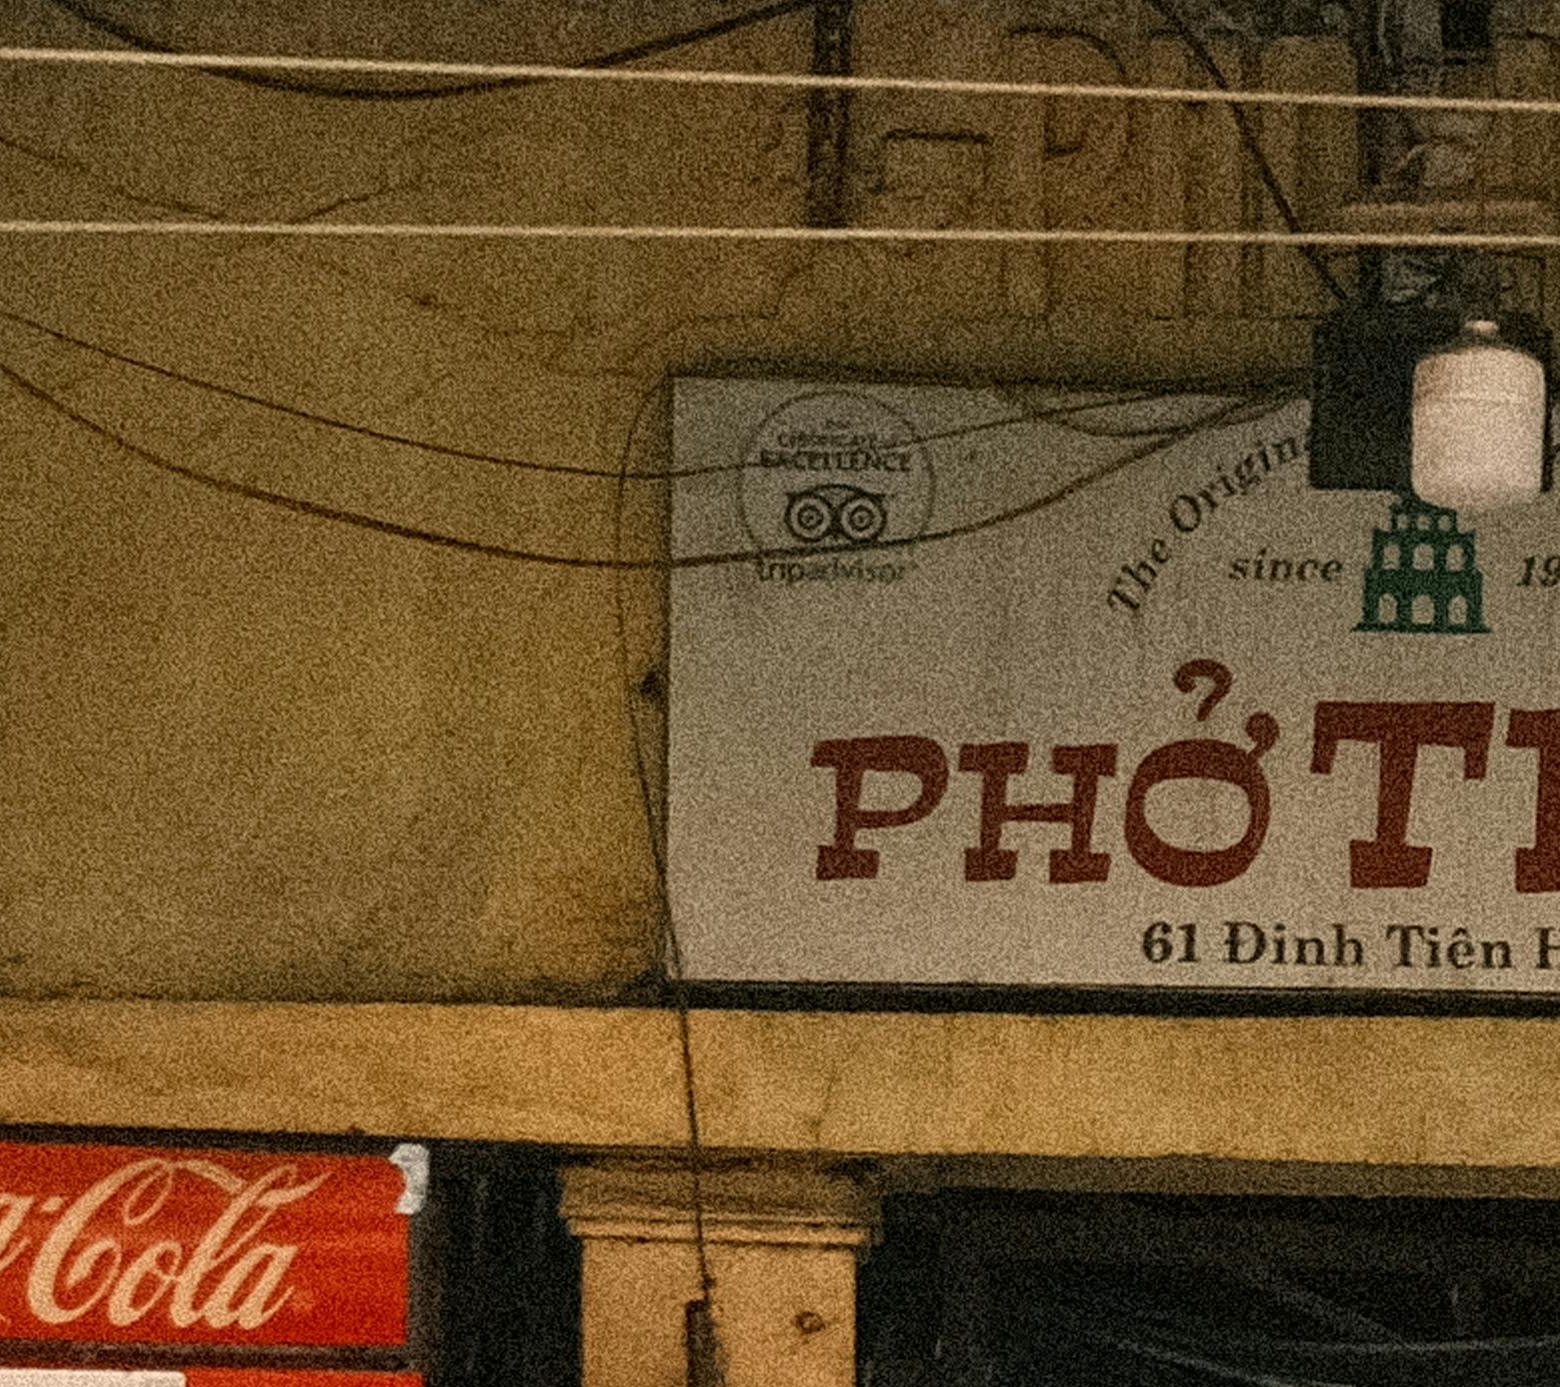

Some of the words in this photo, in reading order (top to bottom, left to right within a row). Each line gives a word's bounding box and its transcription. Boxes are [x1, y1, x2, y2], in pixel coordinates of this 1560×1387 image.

[1103, 536, 1172, 614] The
[1168, 434, 1312, 534] Origin
[1227, 546, 1345, 584] since
[811, 659, 1280, 889] PHỞ
[1141, 920, 1198, 965] 61
[1386, 924, 1514, 973] Tiên
